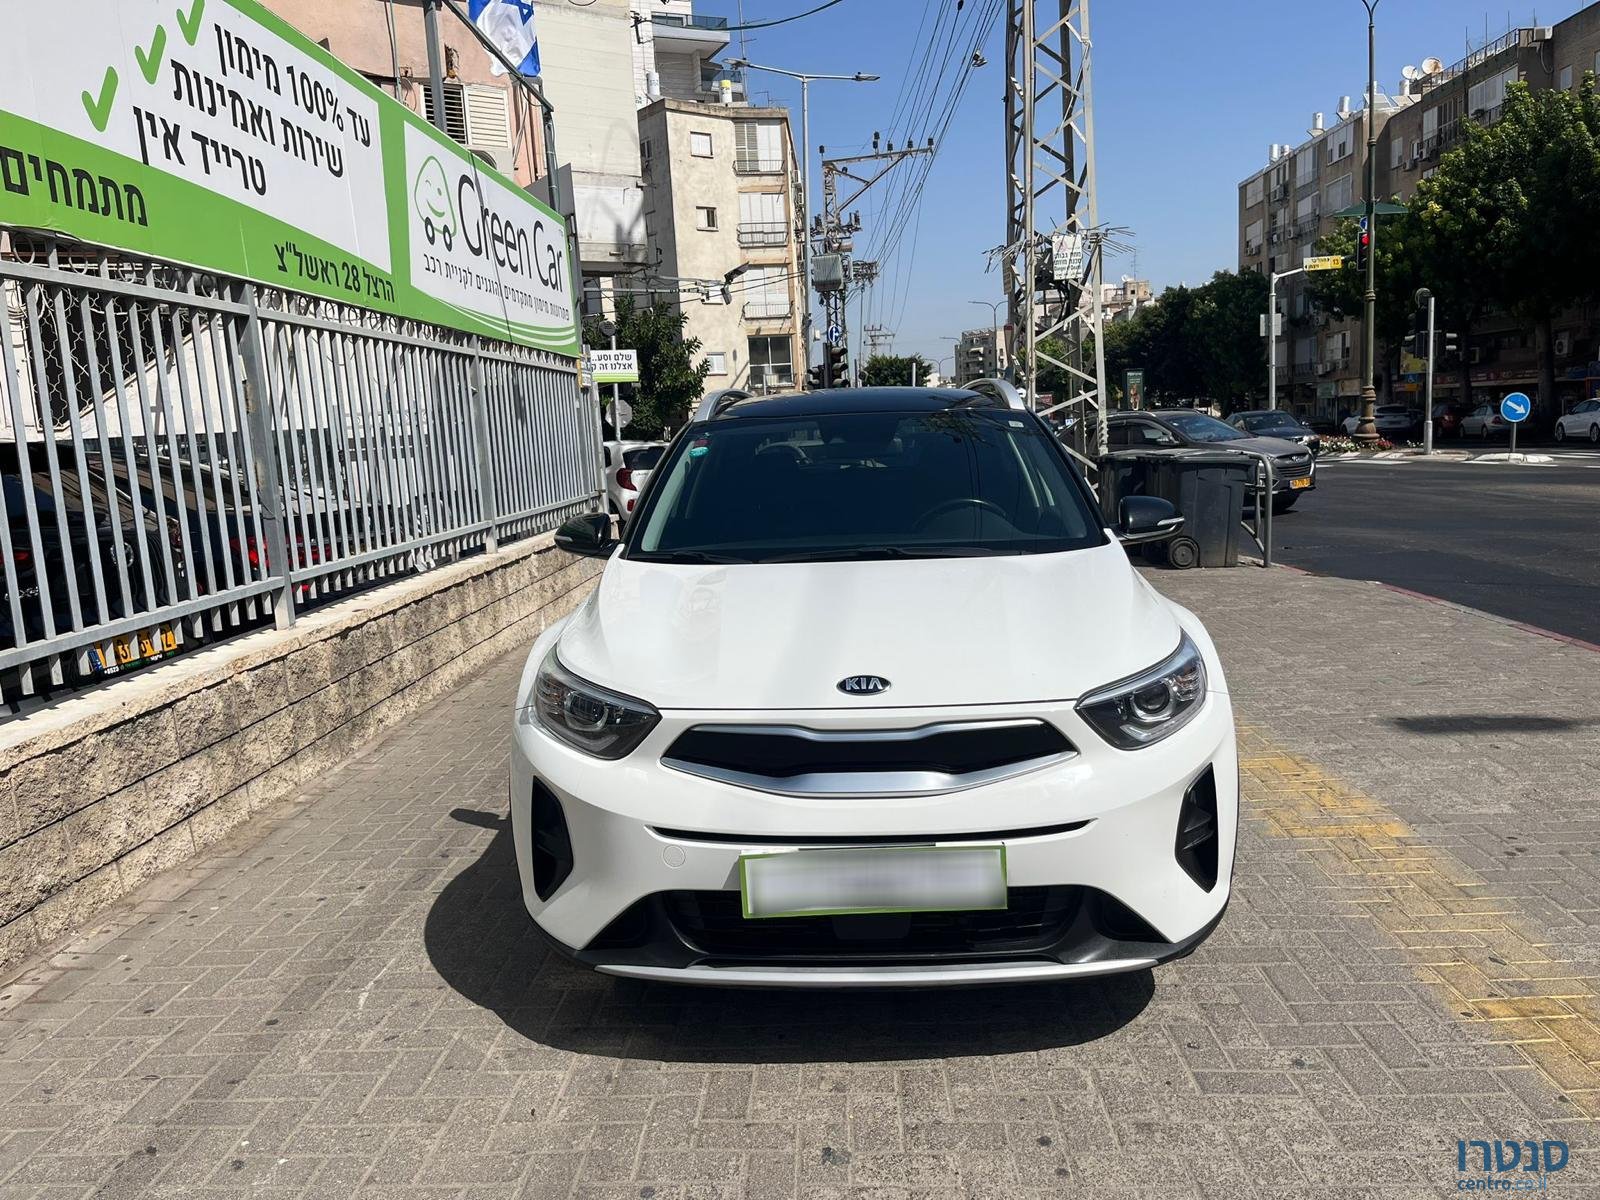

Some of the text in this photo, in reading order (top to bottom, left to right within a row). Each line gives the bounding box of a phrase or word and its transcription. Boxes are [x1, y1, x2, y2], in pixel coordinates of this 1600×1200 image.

[214, 23, 371, 148] עד 100% מימון
[170, 58, 344, 178] שירות ואמינות
[133, 105, 267, 196] טרייד אין
[0, 146, 148, 227] מתמחים
[458, 174, 563, 292] Green Car
[341, 261, 361, 293] 28
[423, 253, 443, 276] רכב
[445, 261, 473, 290] לקניית
[361, 266, 395, 303] הרצל
[610, 362, 633, 370] אצלנו
[613, 352, 632, 361] שלם
[845, 677, 883, 691] KIA
